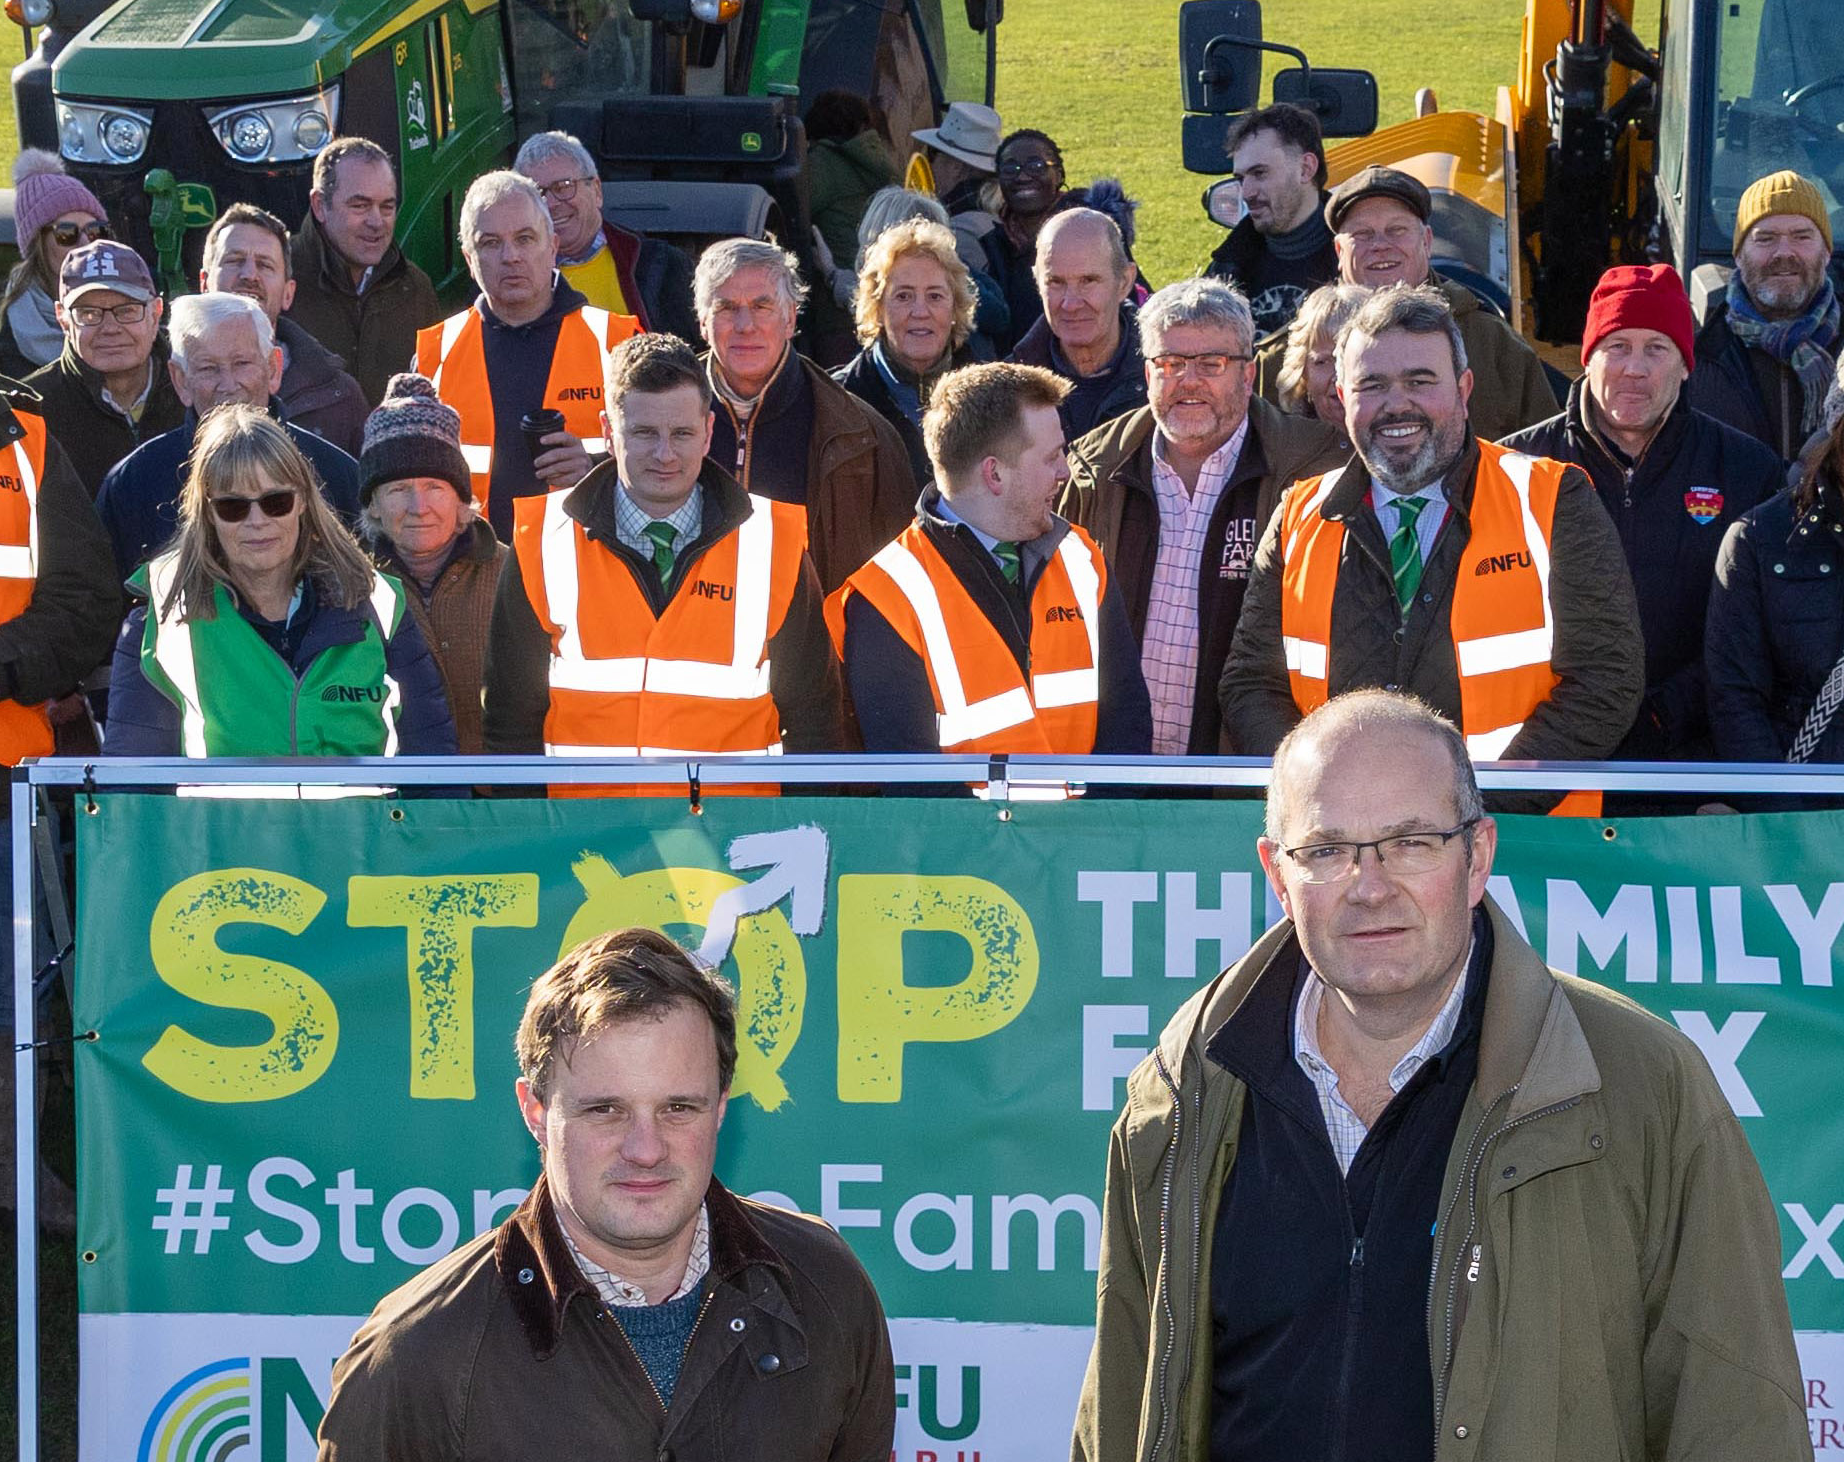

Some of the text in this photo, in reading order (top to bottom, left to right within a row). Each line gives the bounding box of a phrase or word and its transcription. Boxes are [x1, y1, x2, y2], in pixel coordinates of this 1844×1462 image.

[569, 387, 601, 401] NFU
[1490, 552, 1532, 574] NFU
[698, 580, 734, 601] NFU
[338, 685, 383, 704] NFU
[1077, 871, 1293, 978] TH
[143, 852, 1040, 1112] STOP
